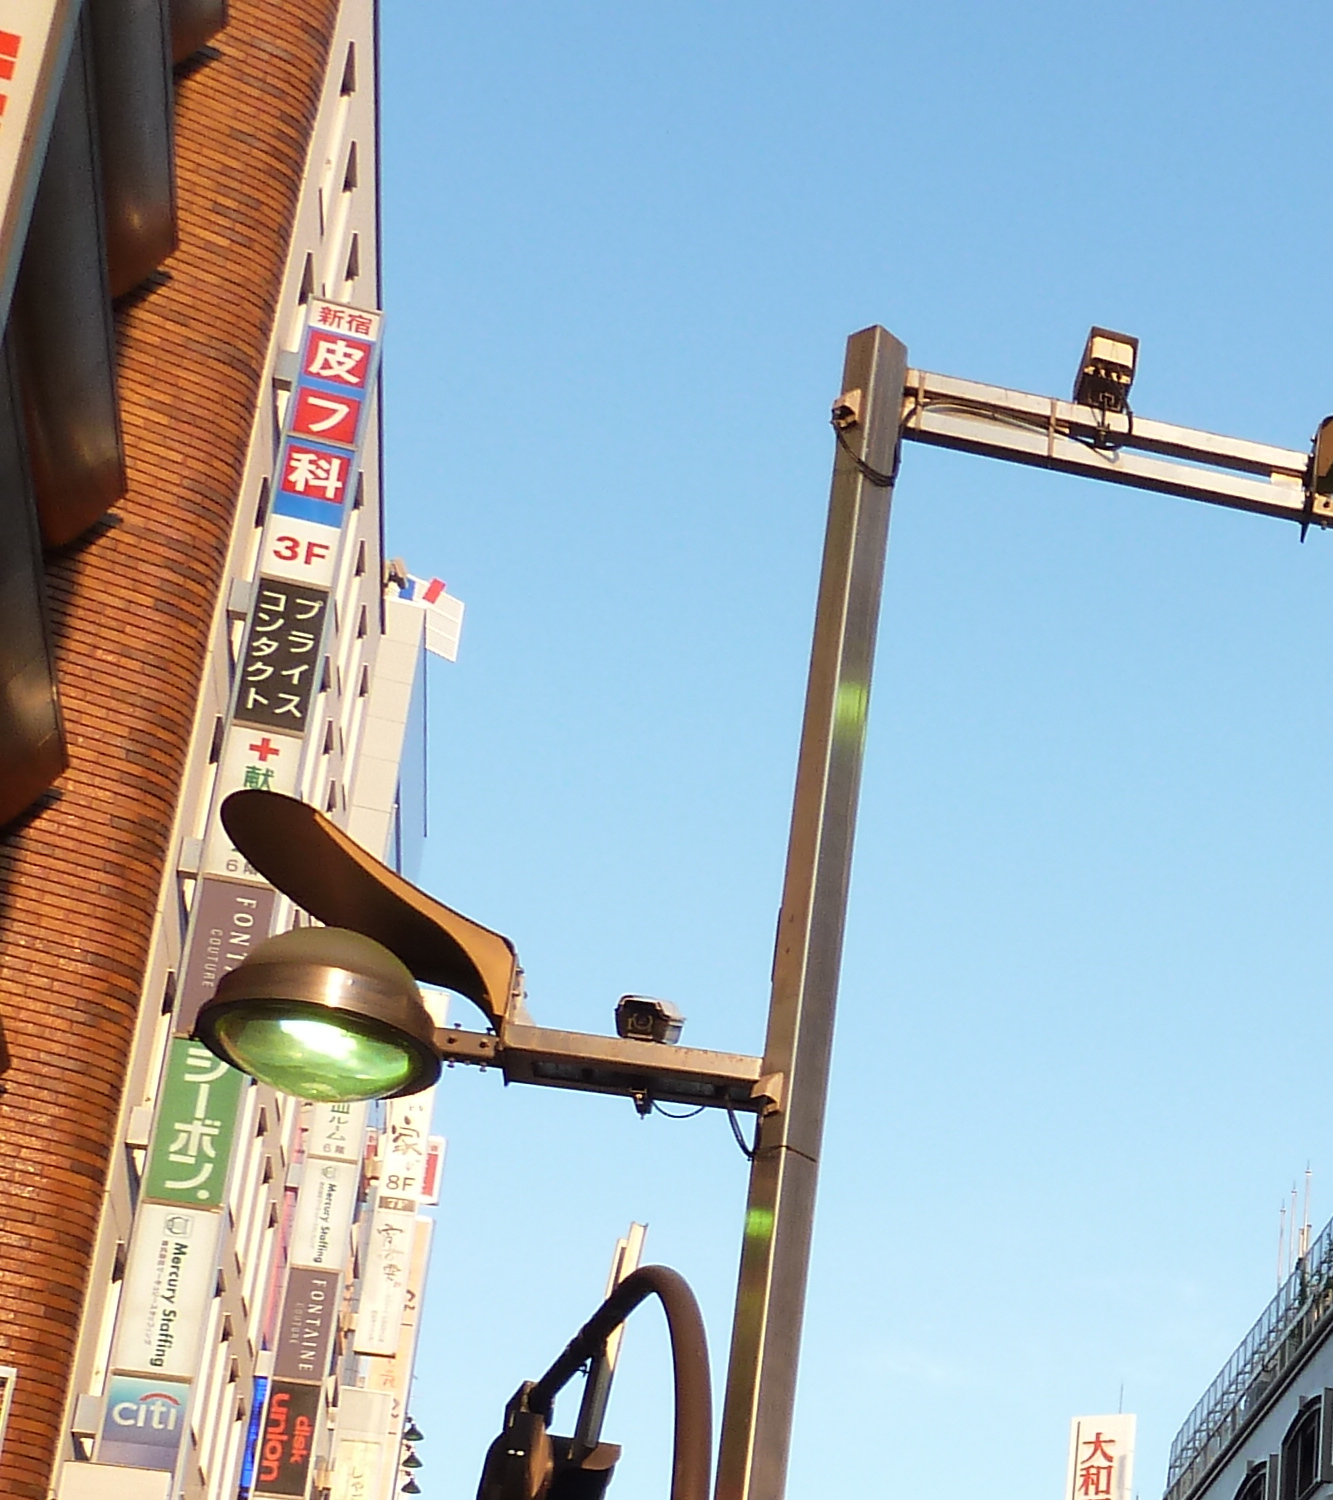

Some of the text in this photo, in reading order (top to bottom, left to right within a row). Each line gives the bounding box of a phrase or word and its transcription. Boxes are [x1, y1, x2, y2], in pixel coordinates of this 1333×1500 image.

[316, 305, 373, 336] 新宿
[287, 339, 367, 498] 皮フ科
[271, 535, 331, 568] 3F
[246, 590, 288, 712] コンタクト
[273, 598, 325, 718] プライス
[313, 1182, 337, 1265] Mercury Staffing
[386, 1175, 416, 1192] 8F
[150, 1242, 189, 1367] Mercury Staffing
[299, 1279, 328, 1372] FONTAINE
[111, 1399, 178, 1432] citi
[260, 1392, 291, 1482] union
[290, 1415, 311, 1464] disk
